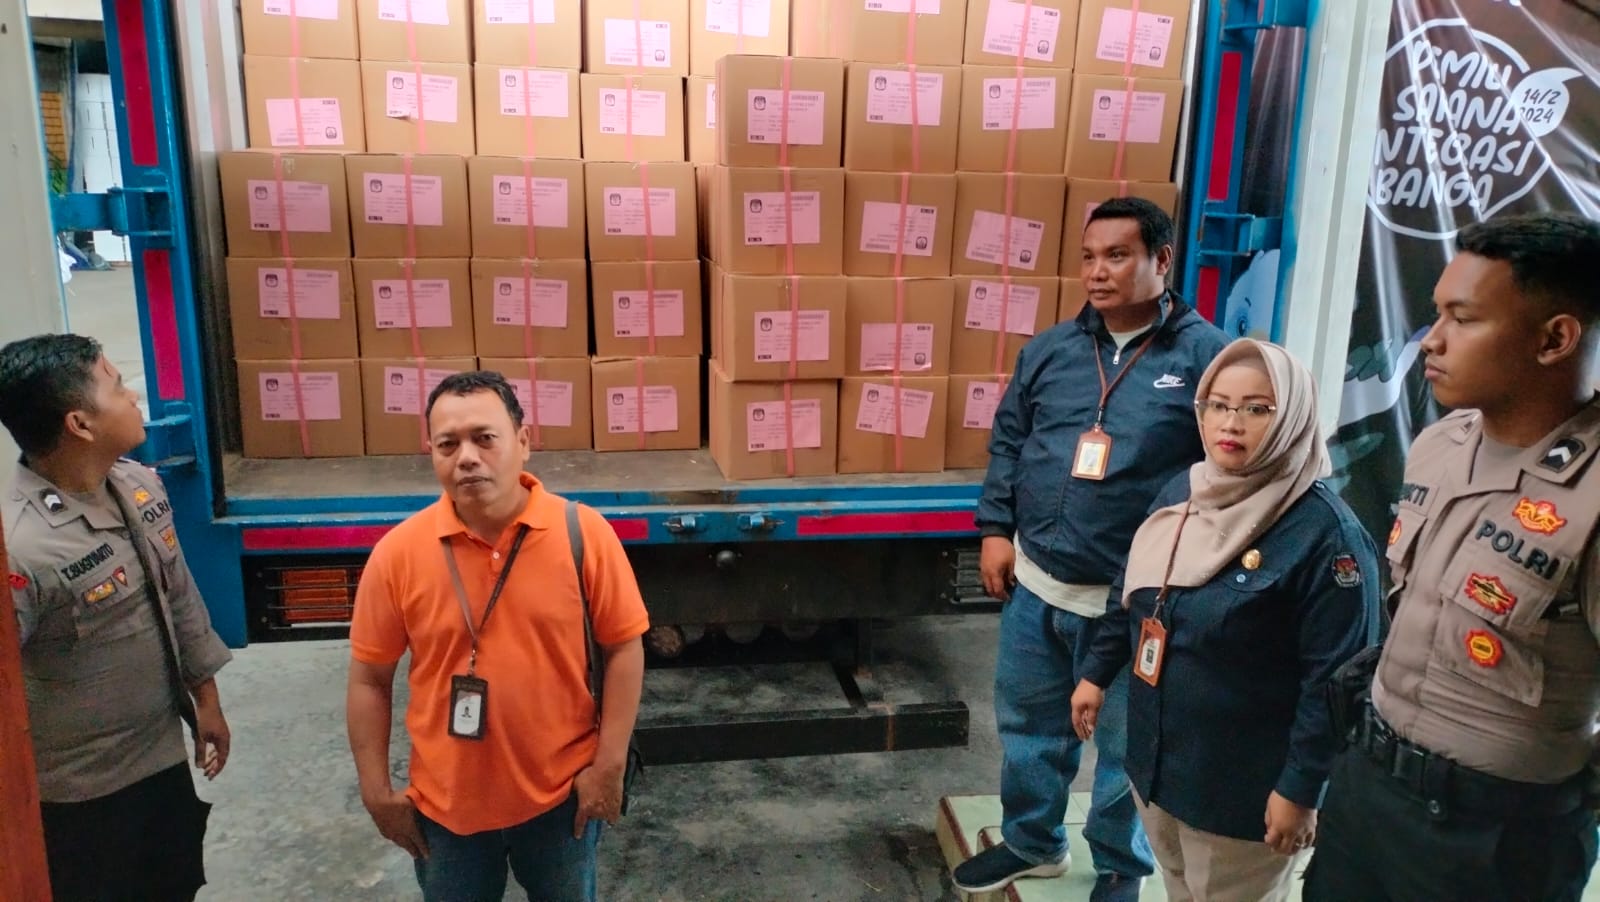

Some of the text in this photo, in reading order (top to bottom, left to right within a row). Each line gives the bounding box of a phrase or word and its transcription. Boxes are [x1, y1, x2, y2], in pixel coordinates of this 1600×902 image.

[1522, 88, 1561, 105] 14/2
[141, 499, 170, 523] OLRI
[1475, 520, 1560, 580] POLRI
